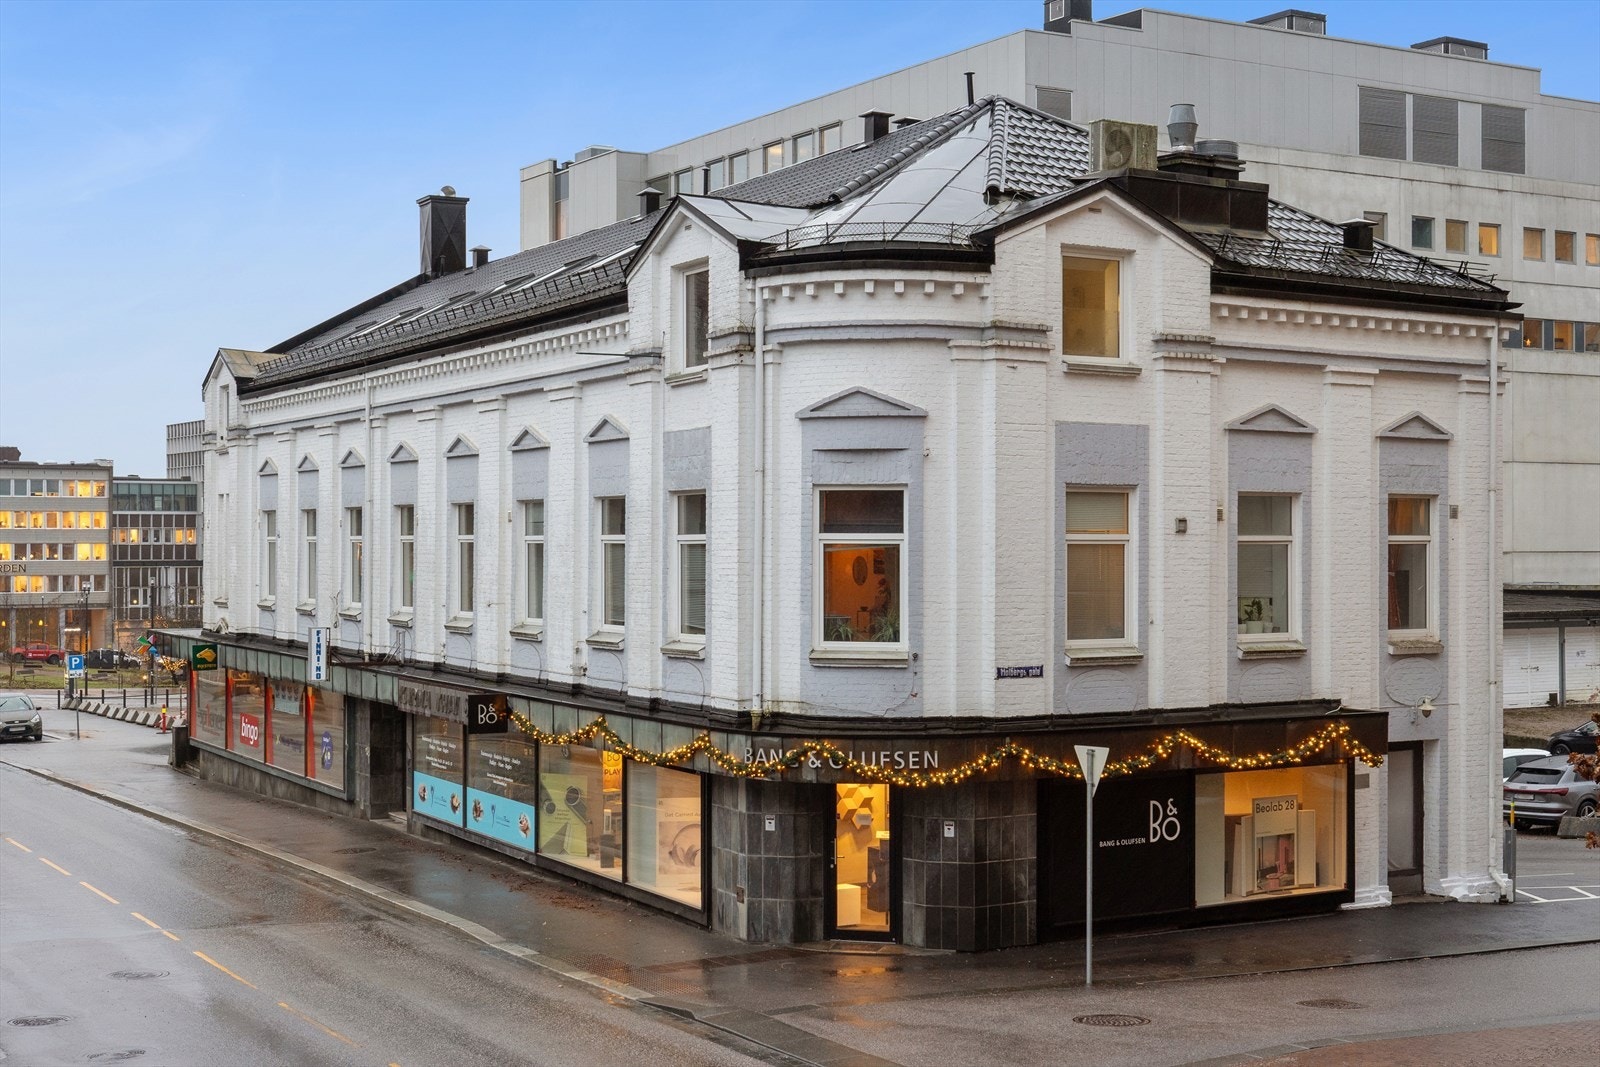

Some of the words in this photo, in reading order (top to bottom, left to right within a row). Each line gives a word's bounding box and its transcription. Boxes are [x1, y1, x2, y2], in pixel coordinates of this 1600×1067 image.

[72, 657, 80, 669] P
[241, 716, 259, 745] bingo
[808, 750, 822, 768] &
[604, 768, 621, 776] PLAY
[1255, 801, 1283, 814] Beolab
[1284, 799, 1295, 811] 28
[1120, 838, 1146, 846] OLUFSEN
